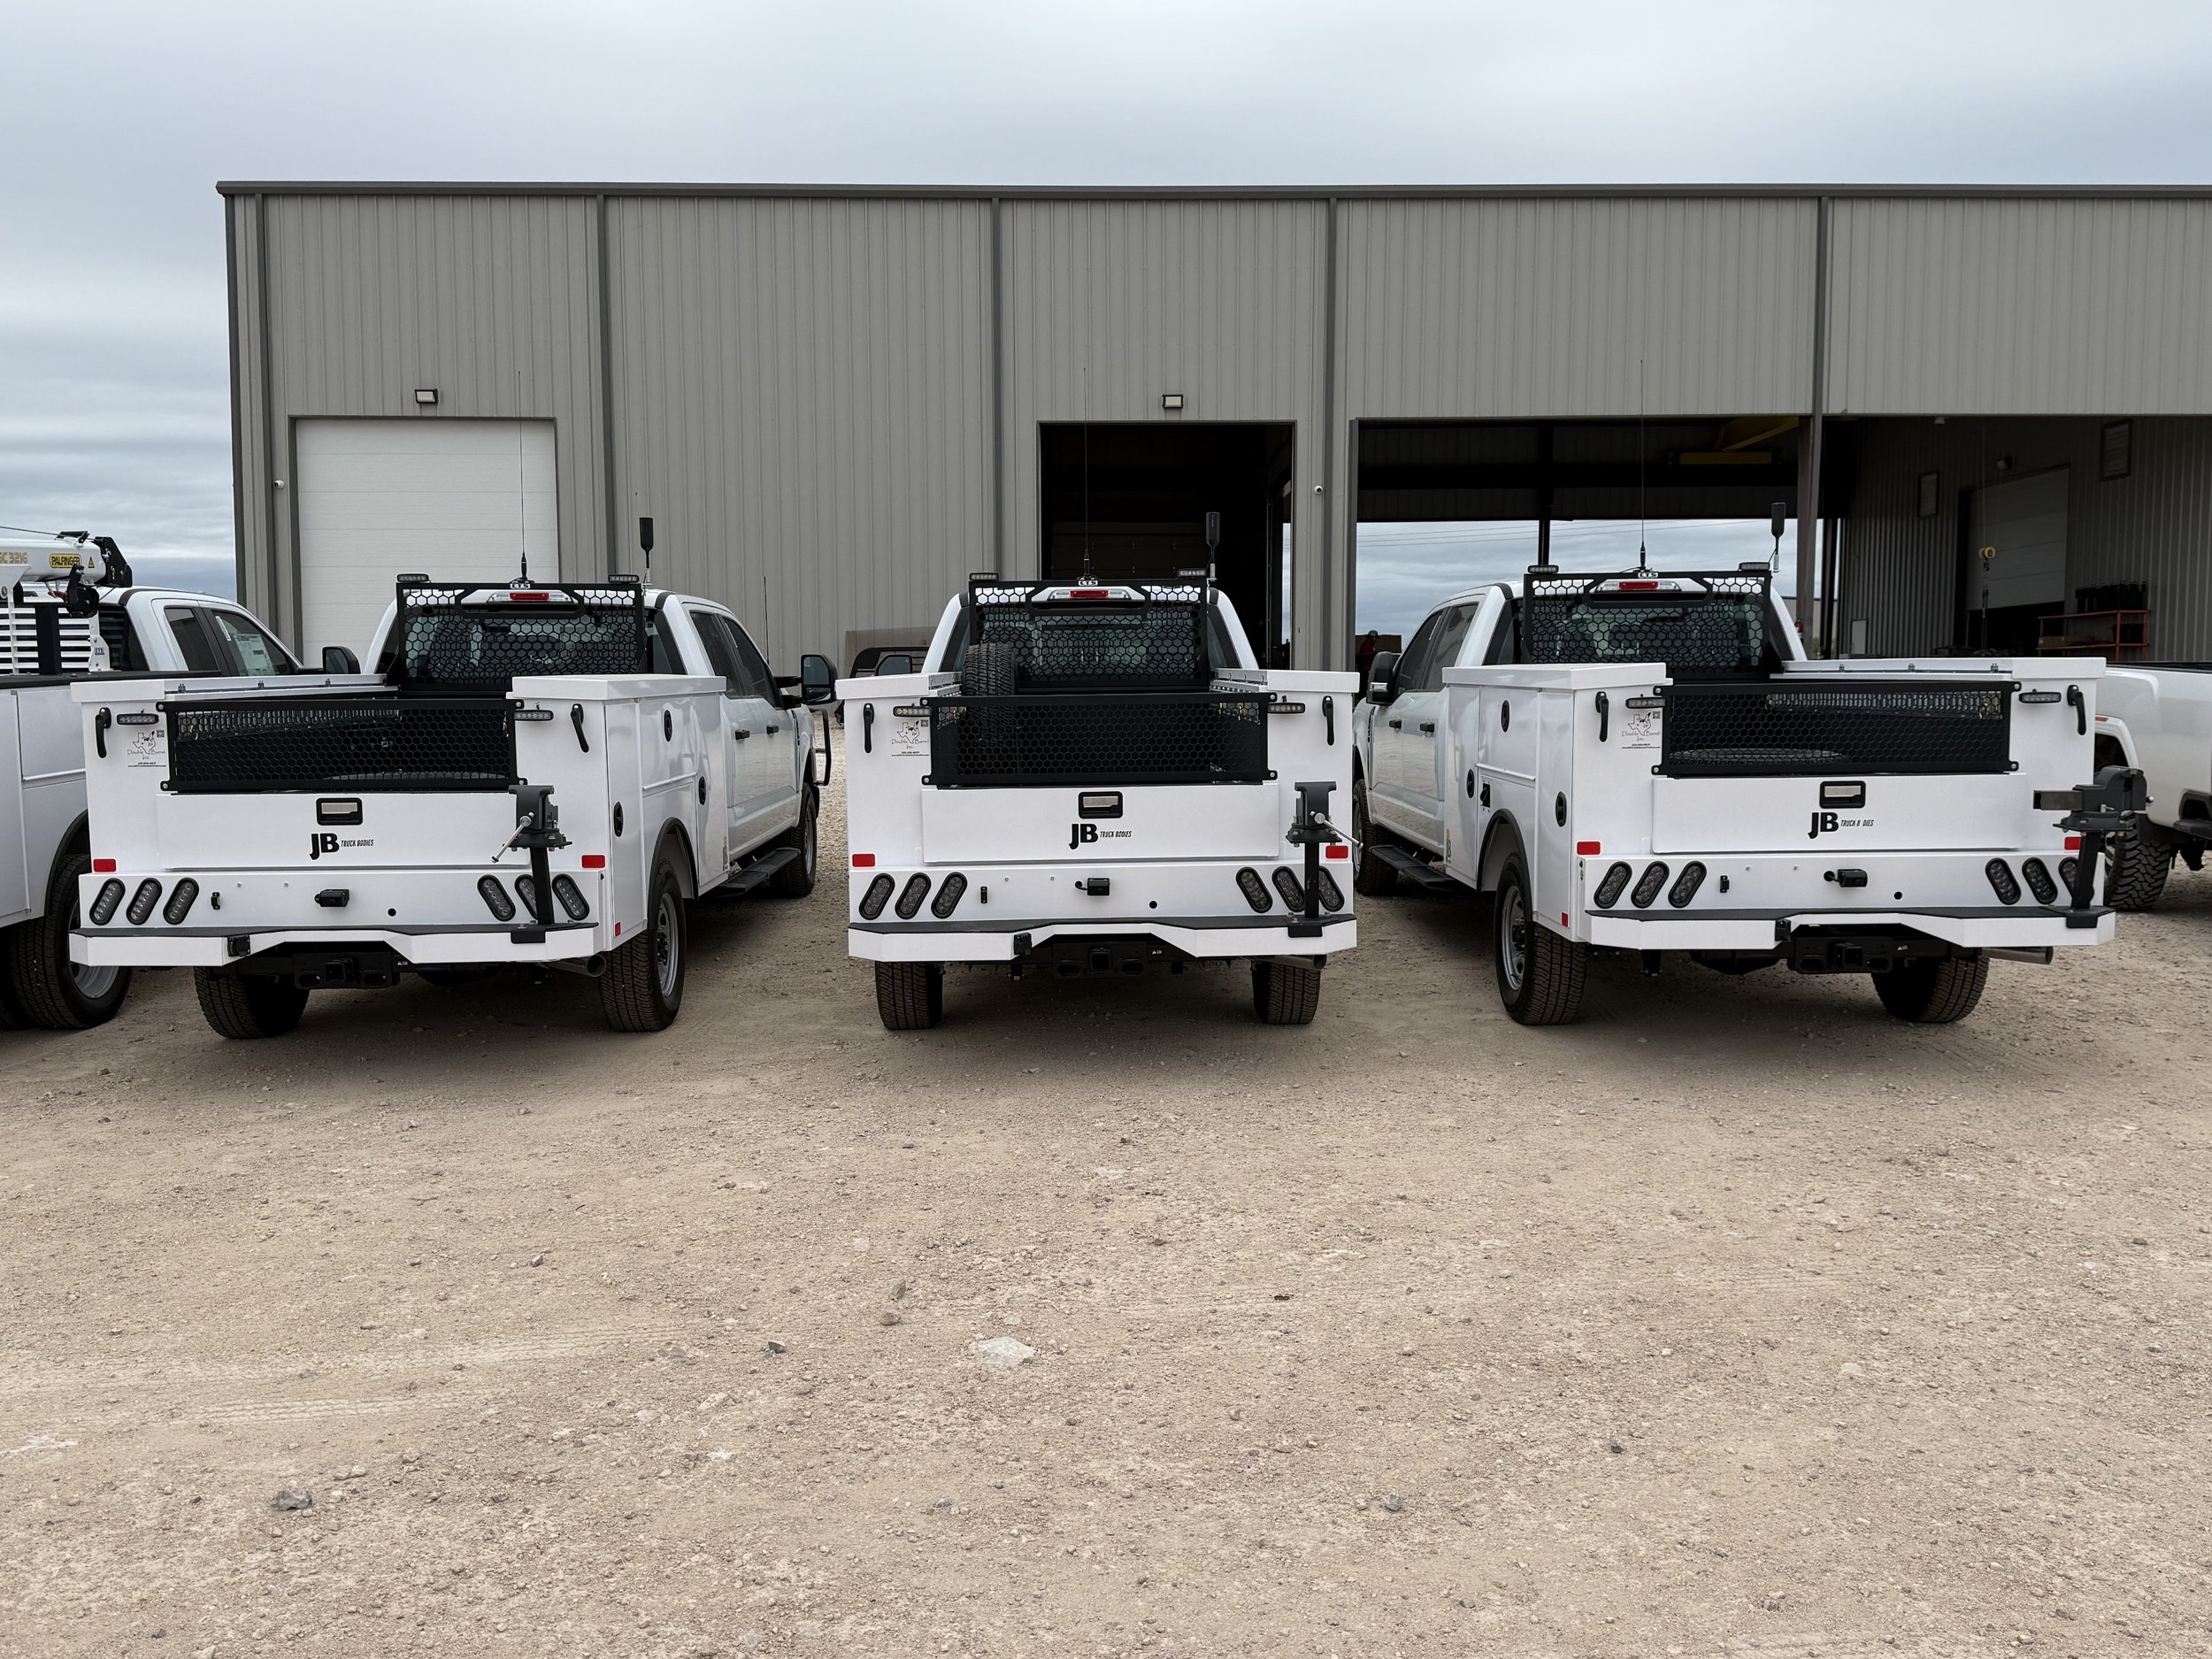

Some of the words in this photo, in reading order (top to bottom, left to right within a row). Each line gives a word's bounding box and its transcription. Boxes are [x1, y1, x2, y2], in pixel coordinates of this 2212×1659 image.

[9, 552, 28, 564] 3216
[51, 556, 81, 565] PALFINGER
[1069, 824, 1099, 849] JB
[1808, 812, 1839, 839] JB
[310, 833, 339, 860] JB
